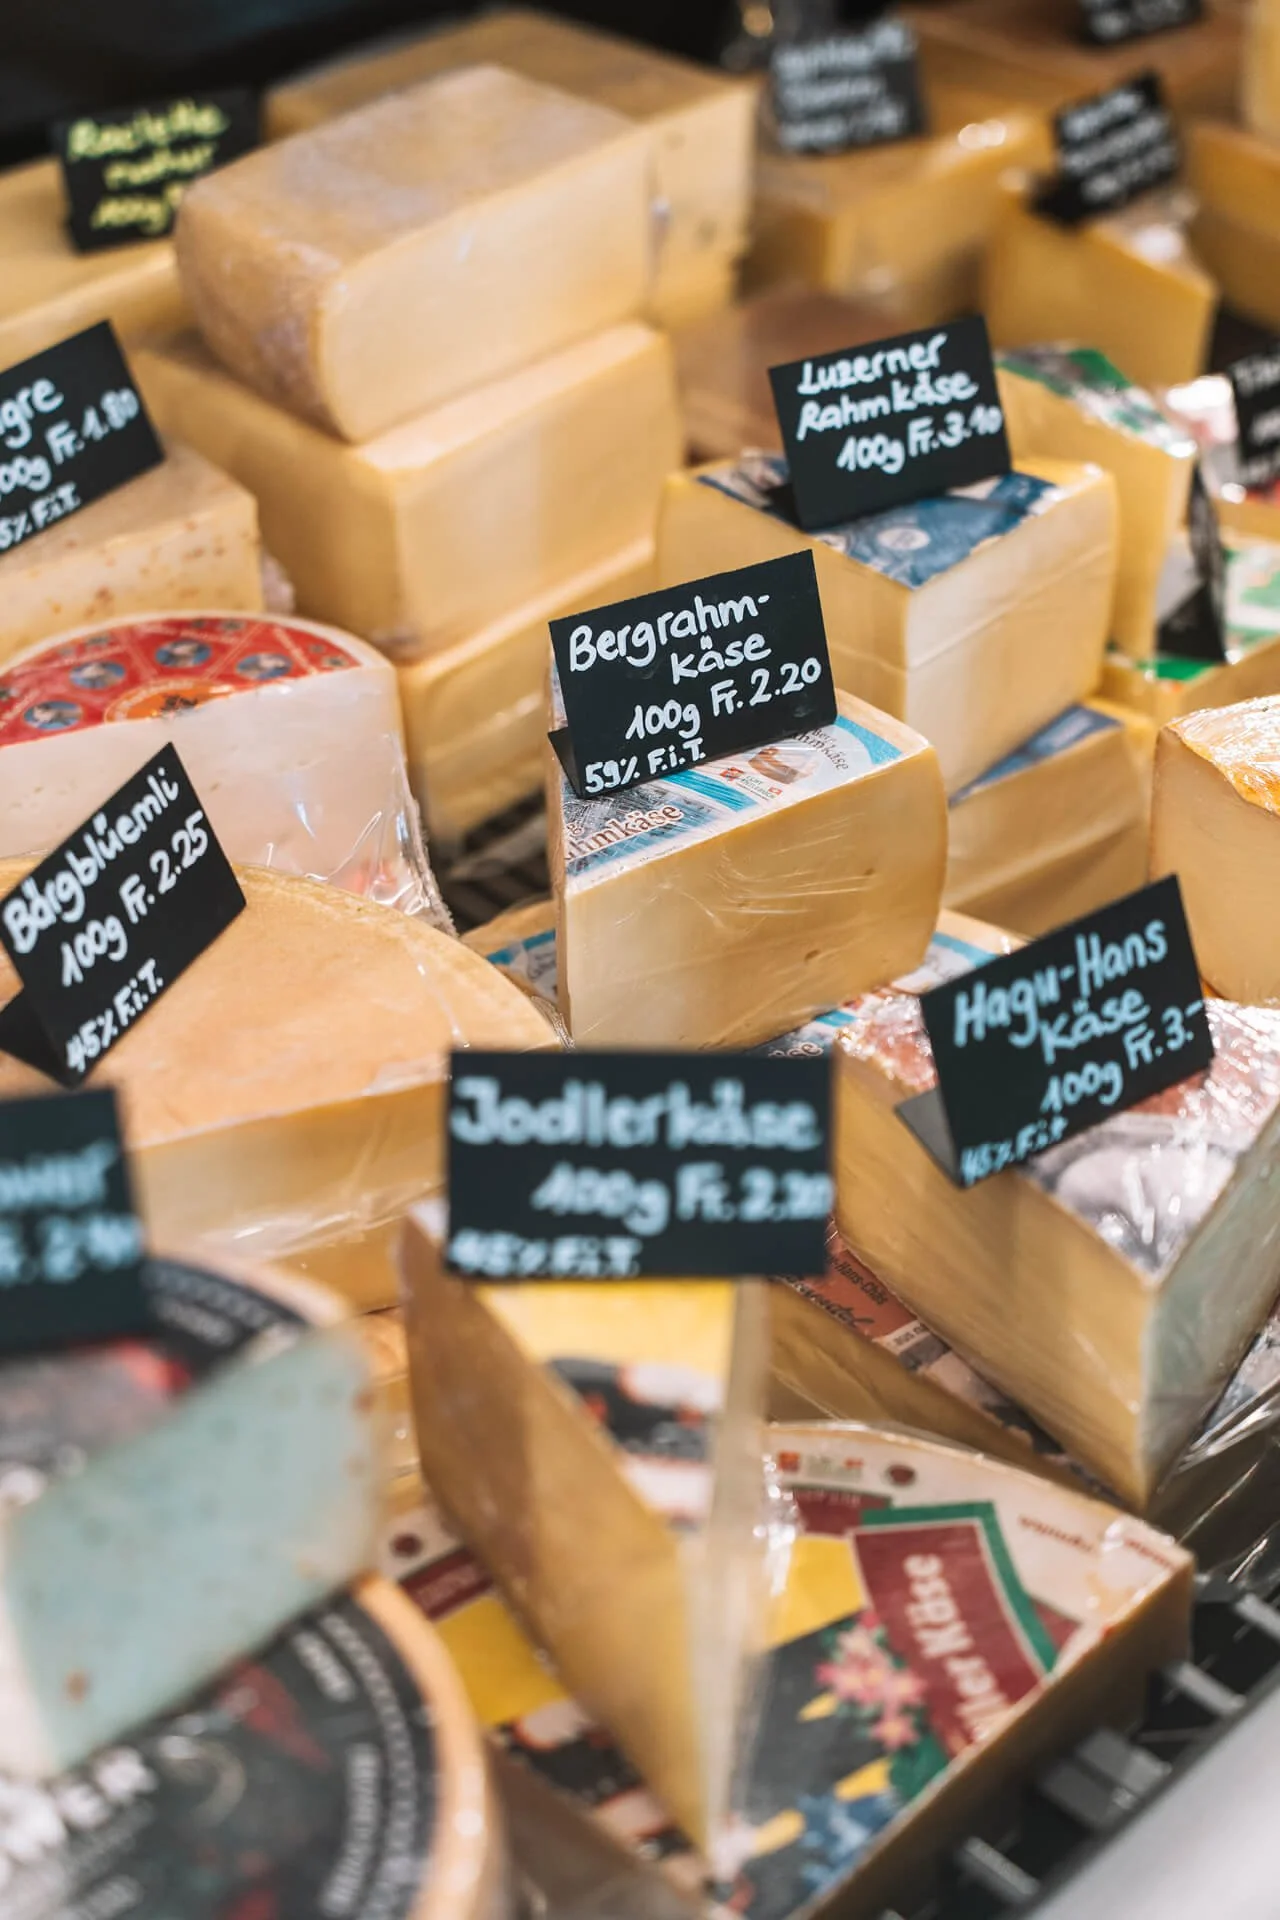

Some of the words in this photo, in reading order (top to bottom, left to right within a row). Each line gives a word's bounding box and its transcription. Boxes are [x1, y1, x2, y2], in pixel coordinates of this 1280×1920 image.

[797, 333, 947, 395] Luzerner
[0, 378, 64, 449] gre
[837, 433, 906, 475] 100g
[908, 415, 939, 457] Fr.
[939, 403, 1003, 447] 3.10
[0, 455, 52, 493] 00g
[45, 420, 85, 465] Fr.
[0, 511, 32, 549] 5%
[569, 594, 770, 672] Bergrahm-
[625, 699, 701, 740] 100g
[710, 679, 744, 717] Fr.
[749, 657, 822, 707] 2.20
[585, 756, 640, 793] 59%
[3, 766, 179, 954] Bärgblüemli
[61, 916, 128, 987] 100g
[119, 874, 156, 924] Fr.
[149, 809, 209, 894] 2.25
[66, 1008, 119, 1074] 45%
[1040, 1061, 1124, 1114] 100g
[1123, 1024, 1163, 1071] Fr.
[450, 1074, 823, 1152] Jodlerkäse
[530, 1161, 670, 1237] 100g
